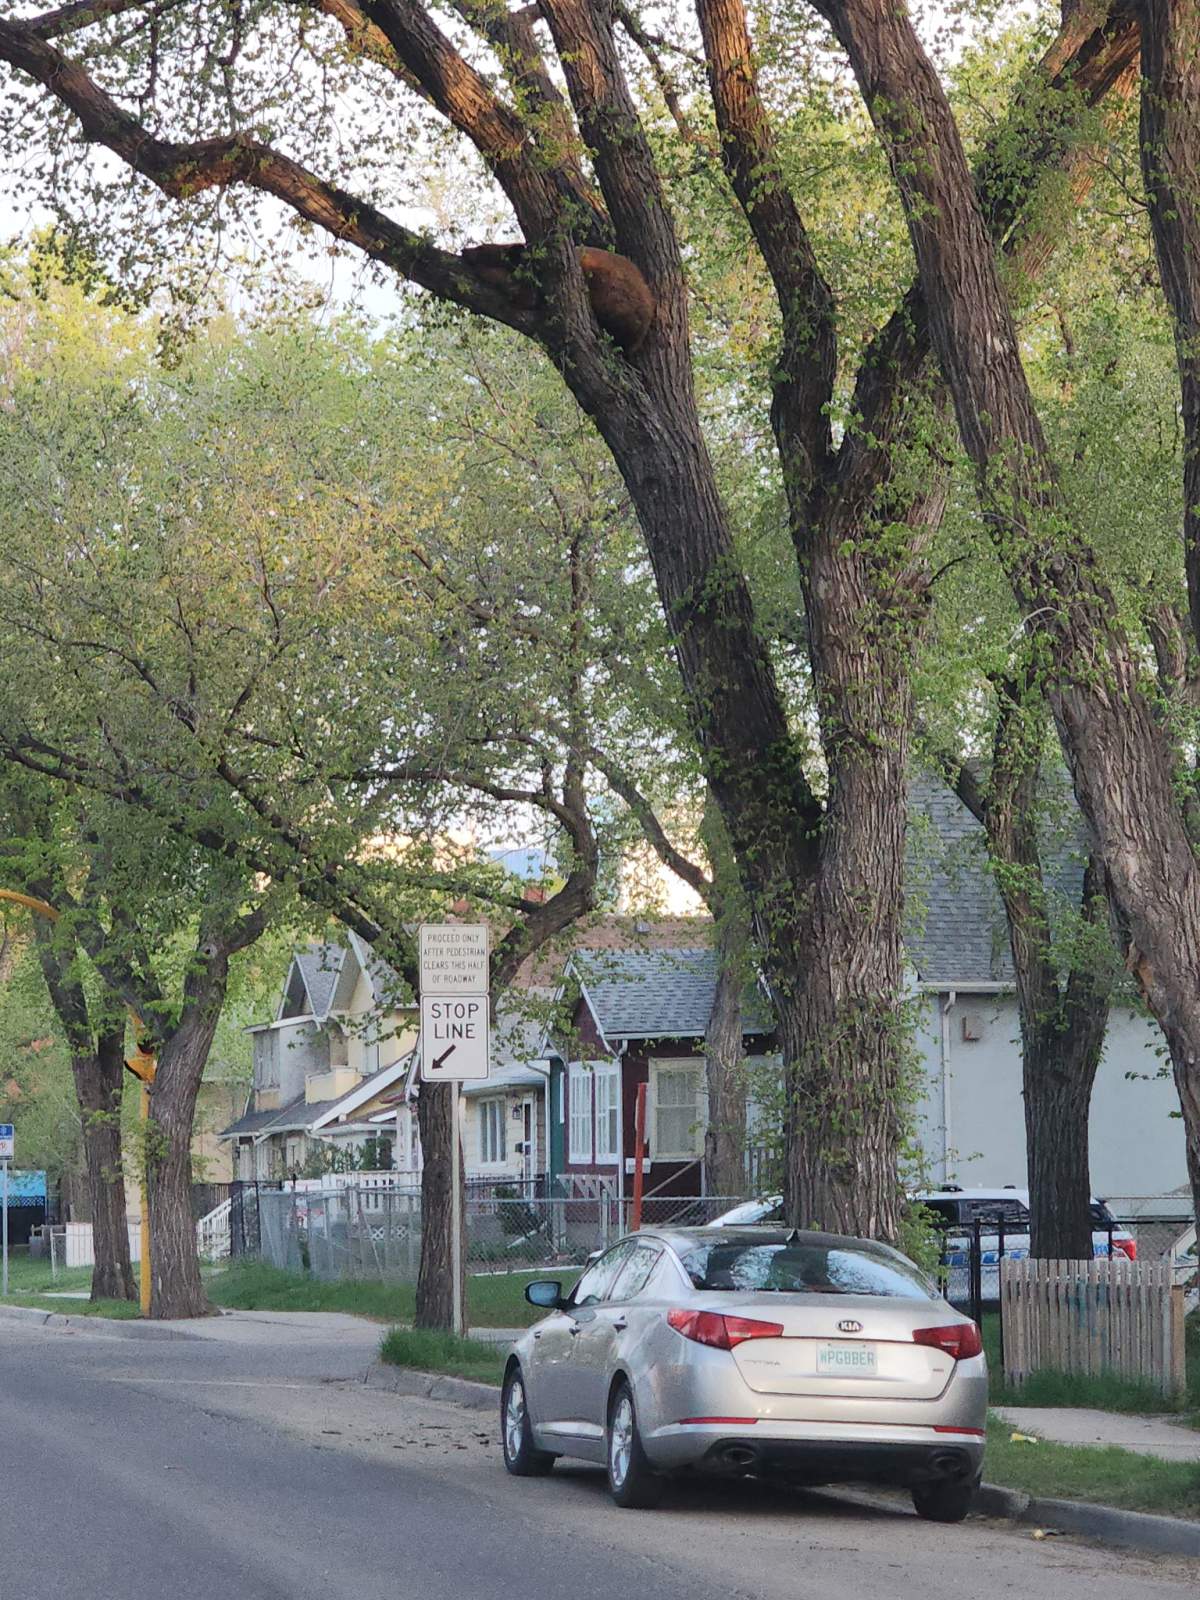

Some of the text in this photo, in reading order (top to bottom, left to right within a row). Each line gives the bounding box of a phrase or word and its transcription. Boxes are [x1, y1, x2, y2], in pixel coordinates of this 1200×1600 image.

[427, 934, 480, 943] PROCEED ONLY
[423, 948, 486, 956] AFTER PEDESTRIAN
[423, 961, 485, 970] CLEARS THIS HALF
[432, 975, 476, 983] OF ROADWAY
[431, 1003, 479, 1019] STOP
[434, 1023, 476, 1039] LINE
[841, 1321, 861, 1331] KIA
